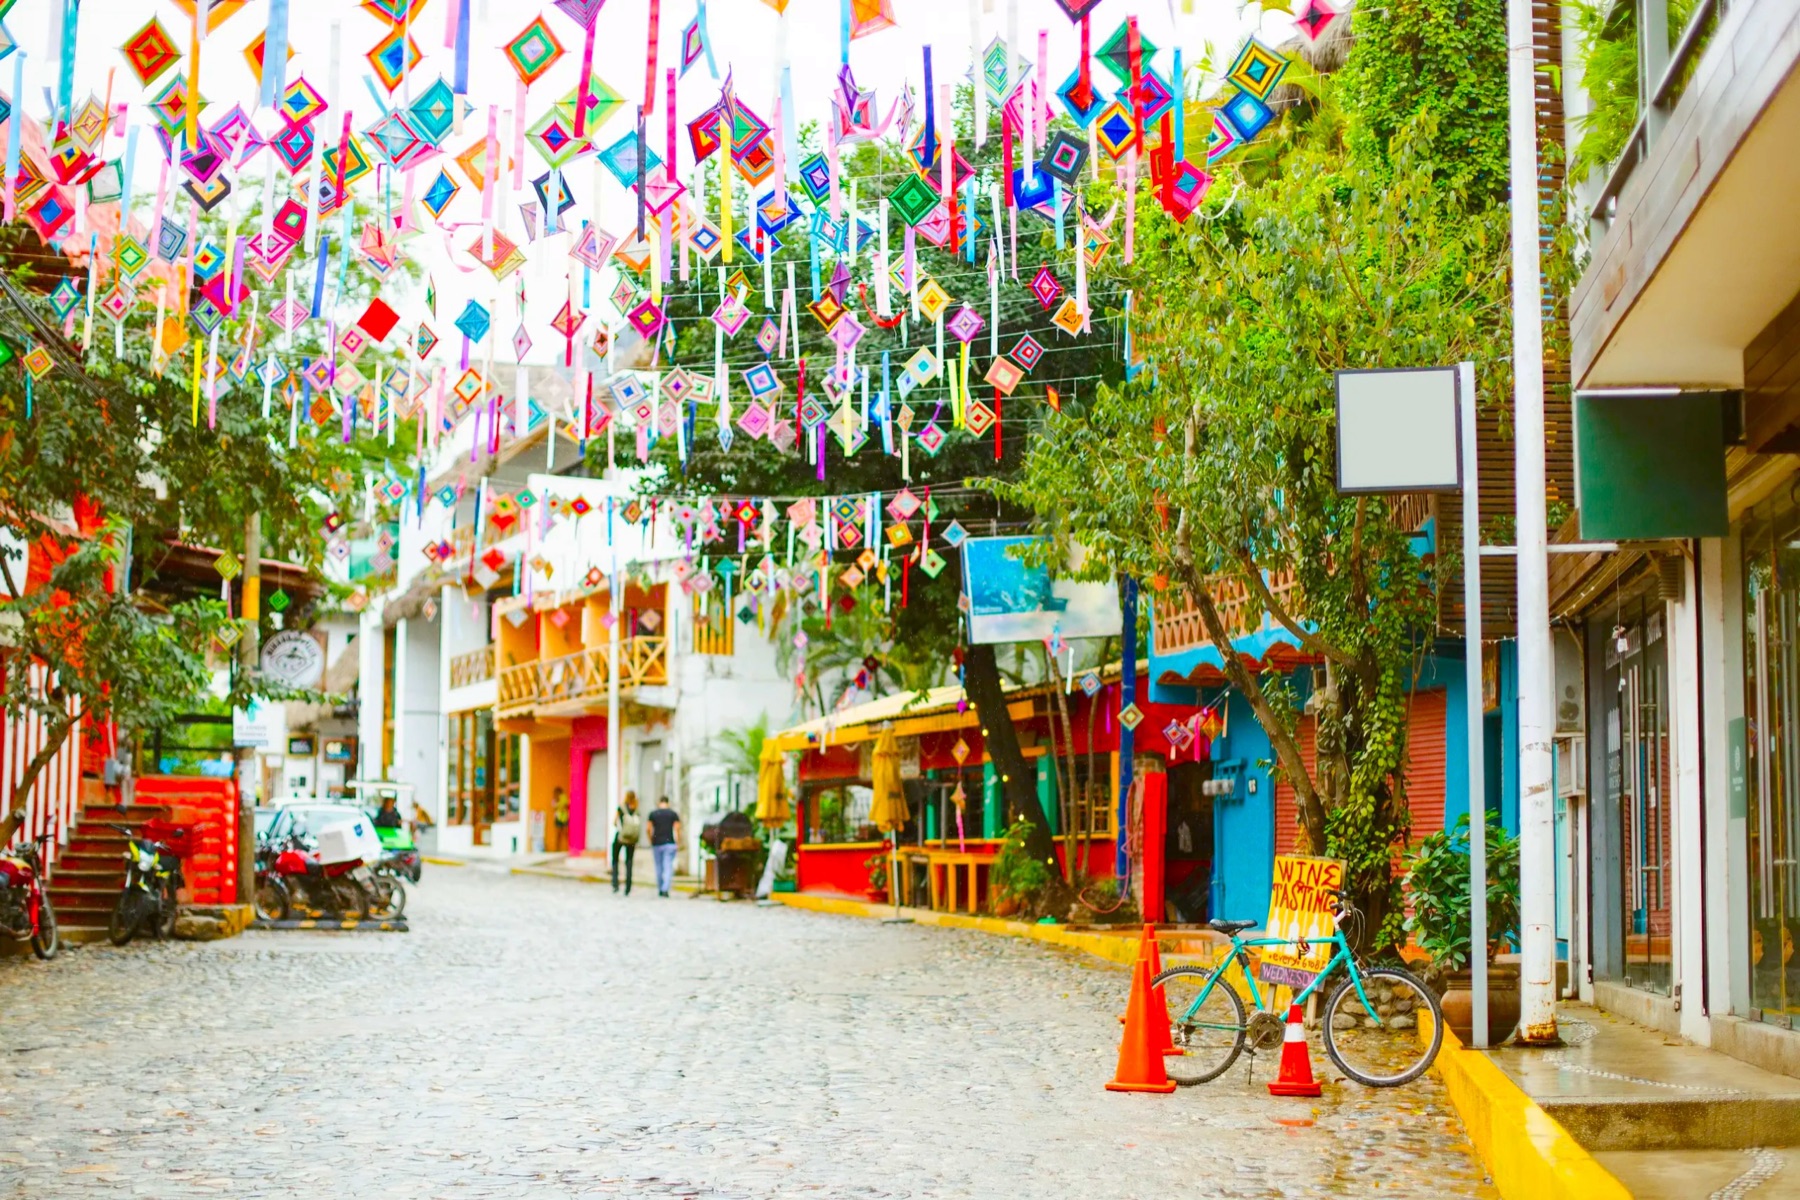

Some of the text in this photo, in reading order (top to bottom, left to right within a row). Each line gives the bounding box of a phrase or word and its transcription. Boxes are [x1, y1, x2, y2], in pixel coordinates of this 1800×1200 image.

[1277, 860, 1340, 890] WINE
[1272, 880, 1338, 916] TASTING
[1262, 963, 1319, 988] WEDNESDA
